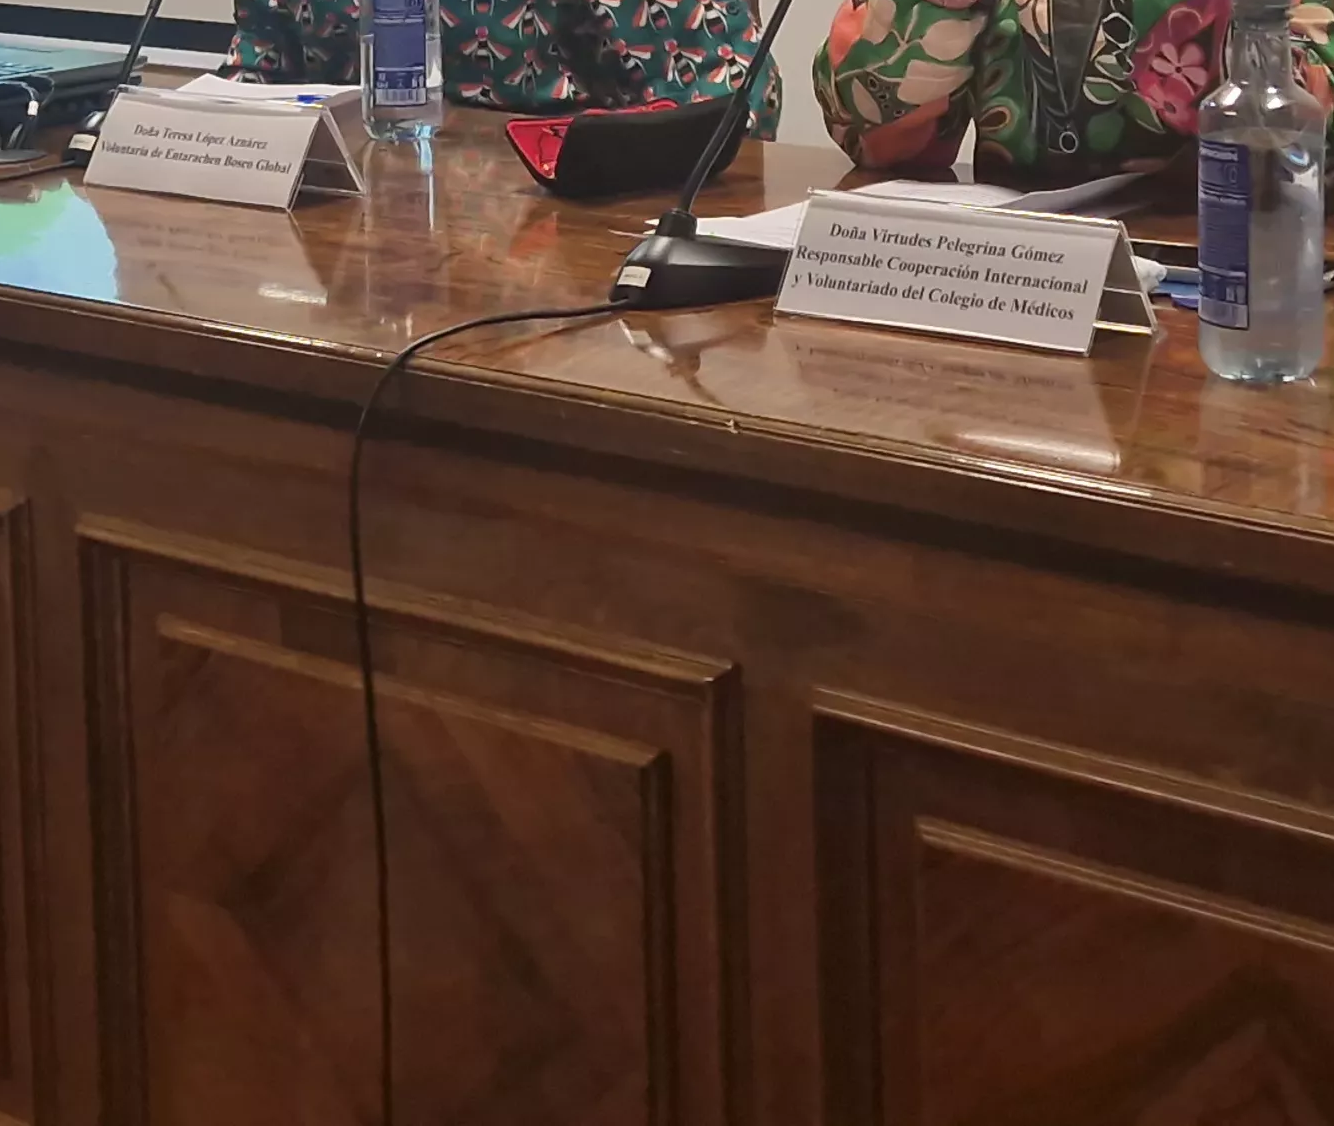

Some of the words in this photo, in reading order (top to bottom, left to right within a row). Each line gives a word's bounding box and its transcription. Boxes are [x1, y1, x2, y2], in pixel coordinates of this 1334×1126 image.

[195, 131, 226, 146] López
[255, 159, 293, 175] Global
[829, 222, 867, 241] Doña
[872, 227, 933, 249] Virtudes
[936, 235, 1007, 257] Pelegrina
[1011, 244, 1065, 265] Gómez
[796, 245, 884, 269] Responsable
[886, 256, 980, 282] Cooperación
[984, 268, 1089, 295] Internacional
[791, 274, 803, 288] y
[806, 272, 899, 298] Voluntariado
[901, 285, 925, 301] del
[928, 287, 985, 311] Colegio
[987, 296, 1007, 312] de
[1009, 298, 1075, 321] Médicos
